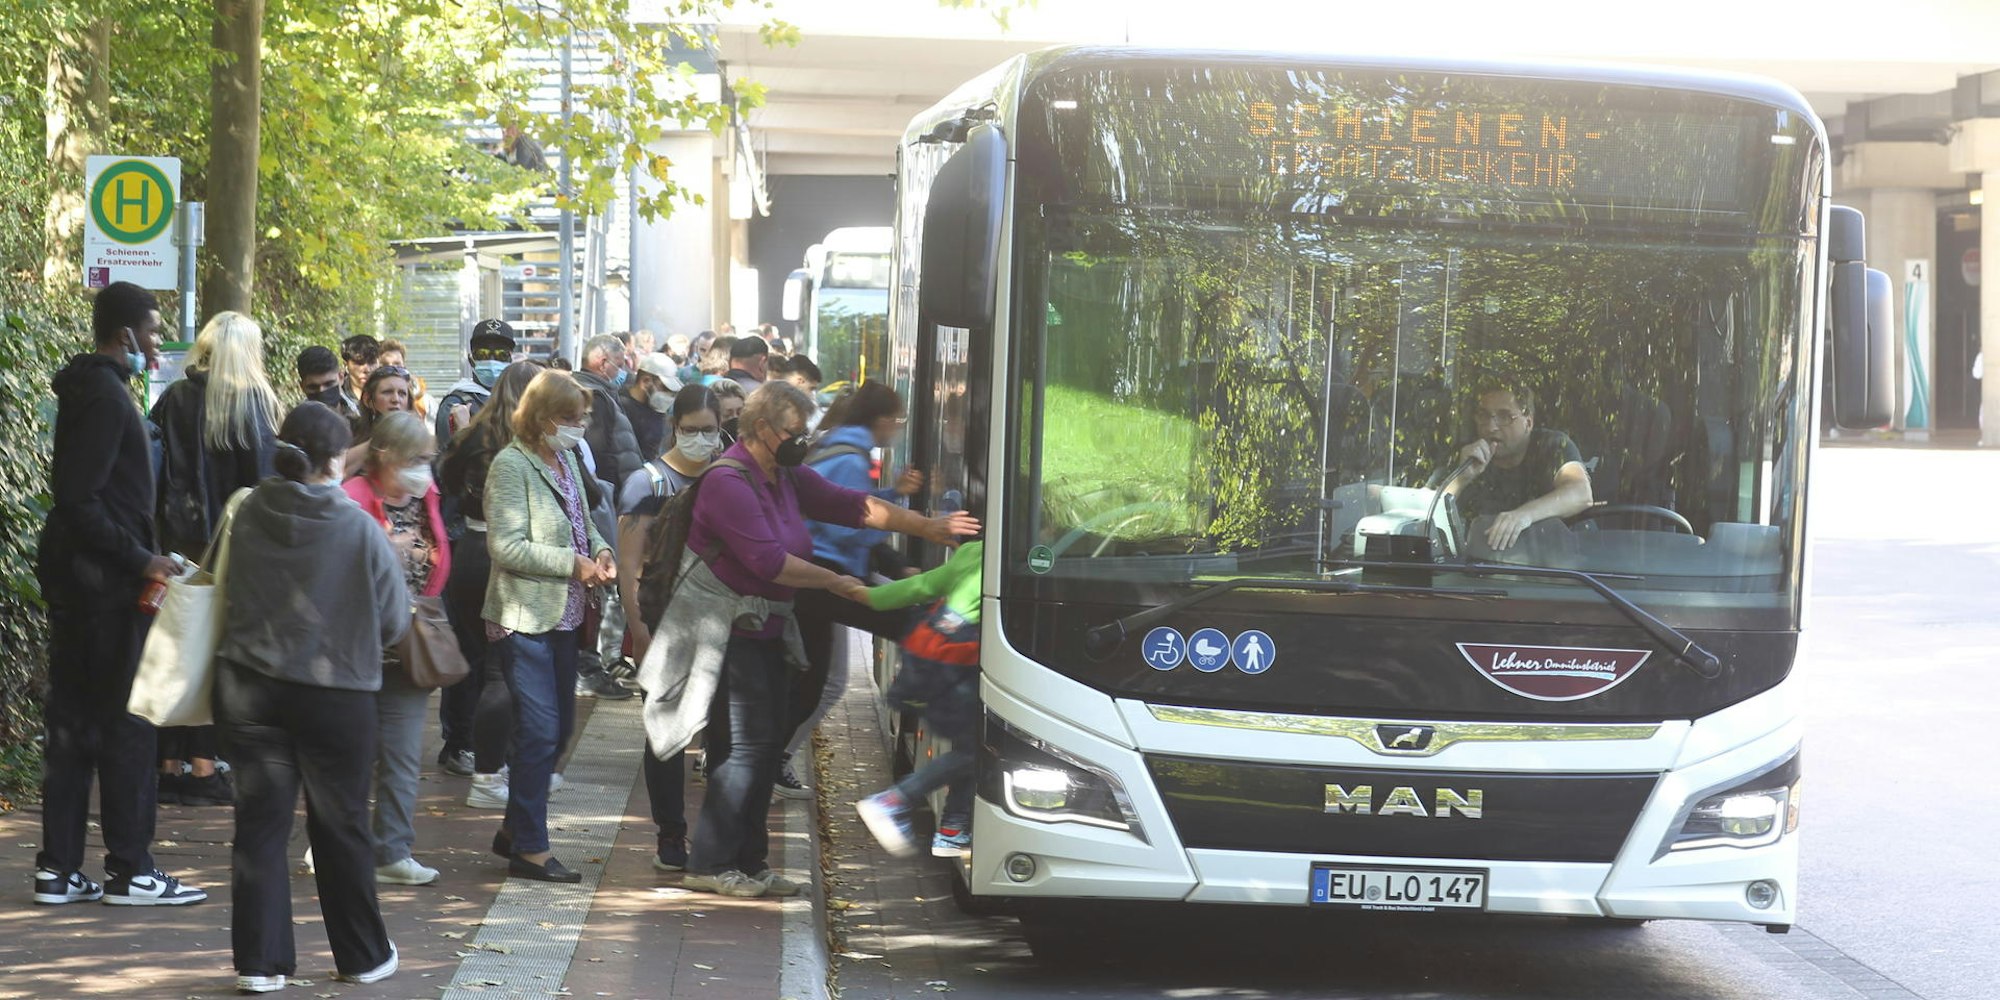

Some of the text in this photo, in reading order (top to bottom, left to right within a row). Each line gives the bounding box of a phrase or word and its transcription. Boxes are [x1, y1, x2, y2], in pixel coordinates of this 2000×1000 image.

[1250, 102, 1601, 150] SCHIENEN-
[116, 179, 149, 225] H
[97, 257, 163, 267] Ersatzverkehr
[106, 248, 149, 256] Schienen
[1912, 264, 1922, 280] 4
[1492, 651, 1616, 672] Lehner Omnibusbetrieb
[1324, 784, 1483, 819] MAN
[1330, 873, 1366, 900] EU
[1385, 875, 1421, 902] LO
[1428, 876, 1481, 903] 147
